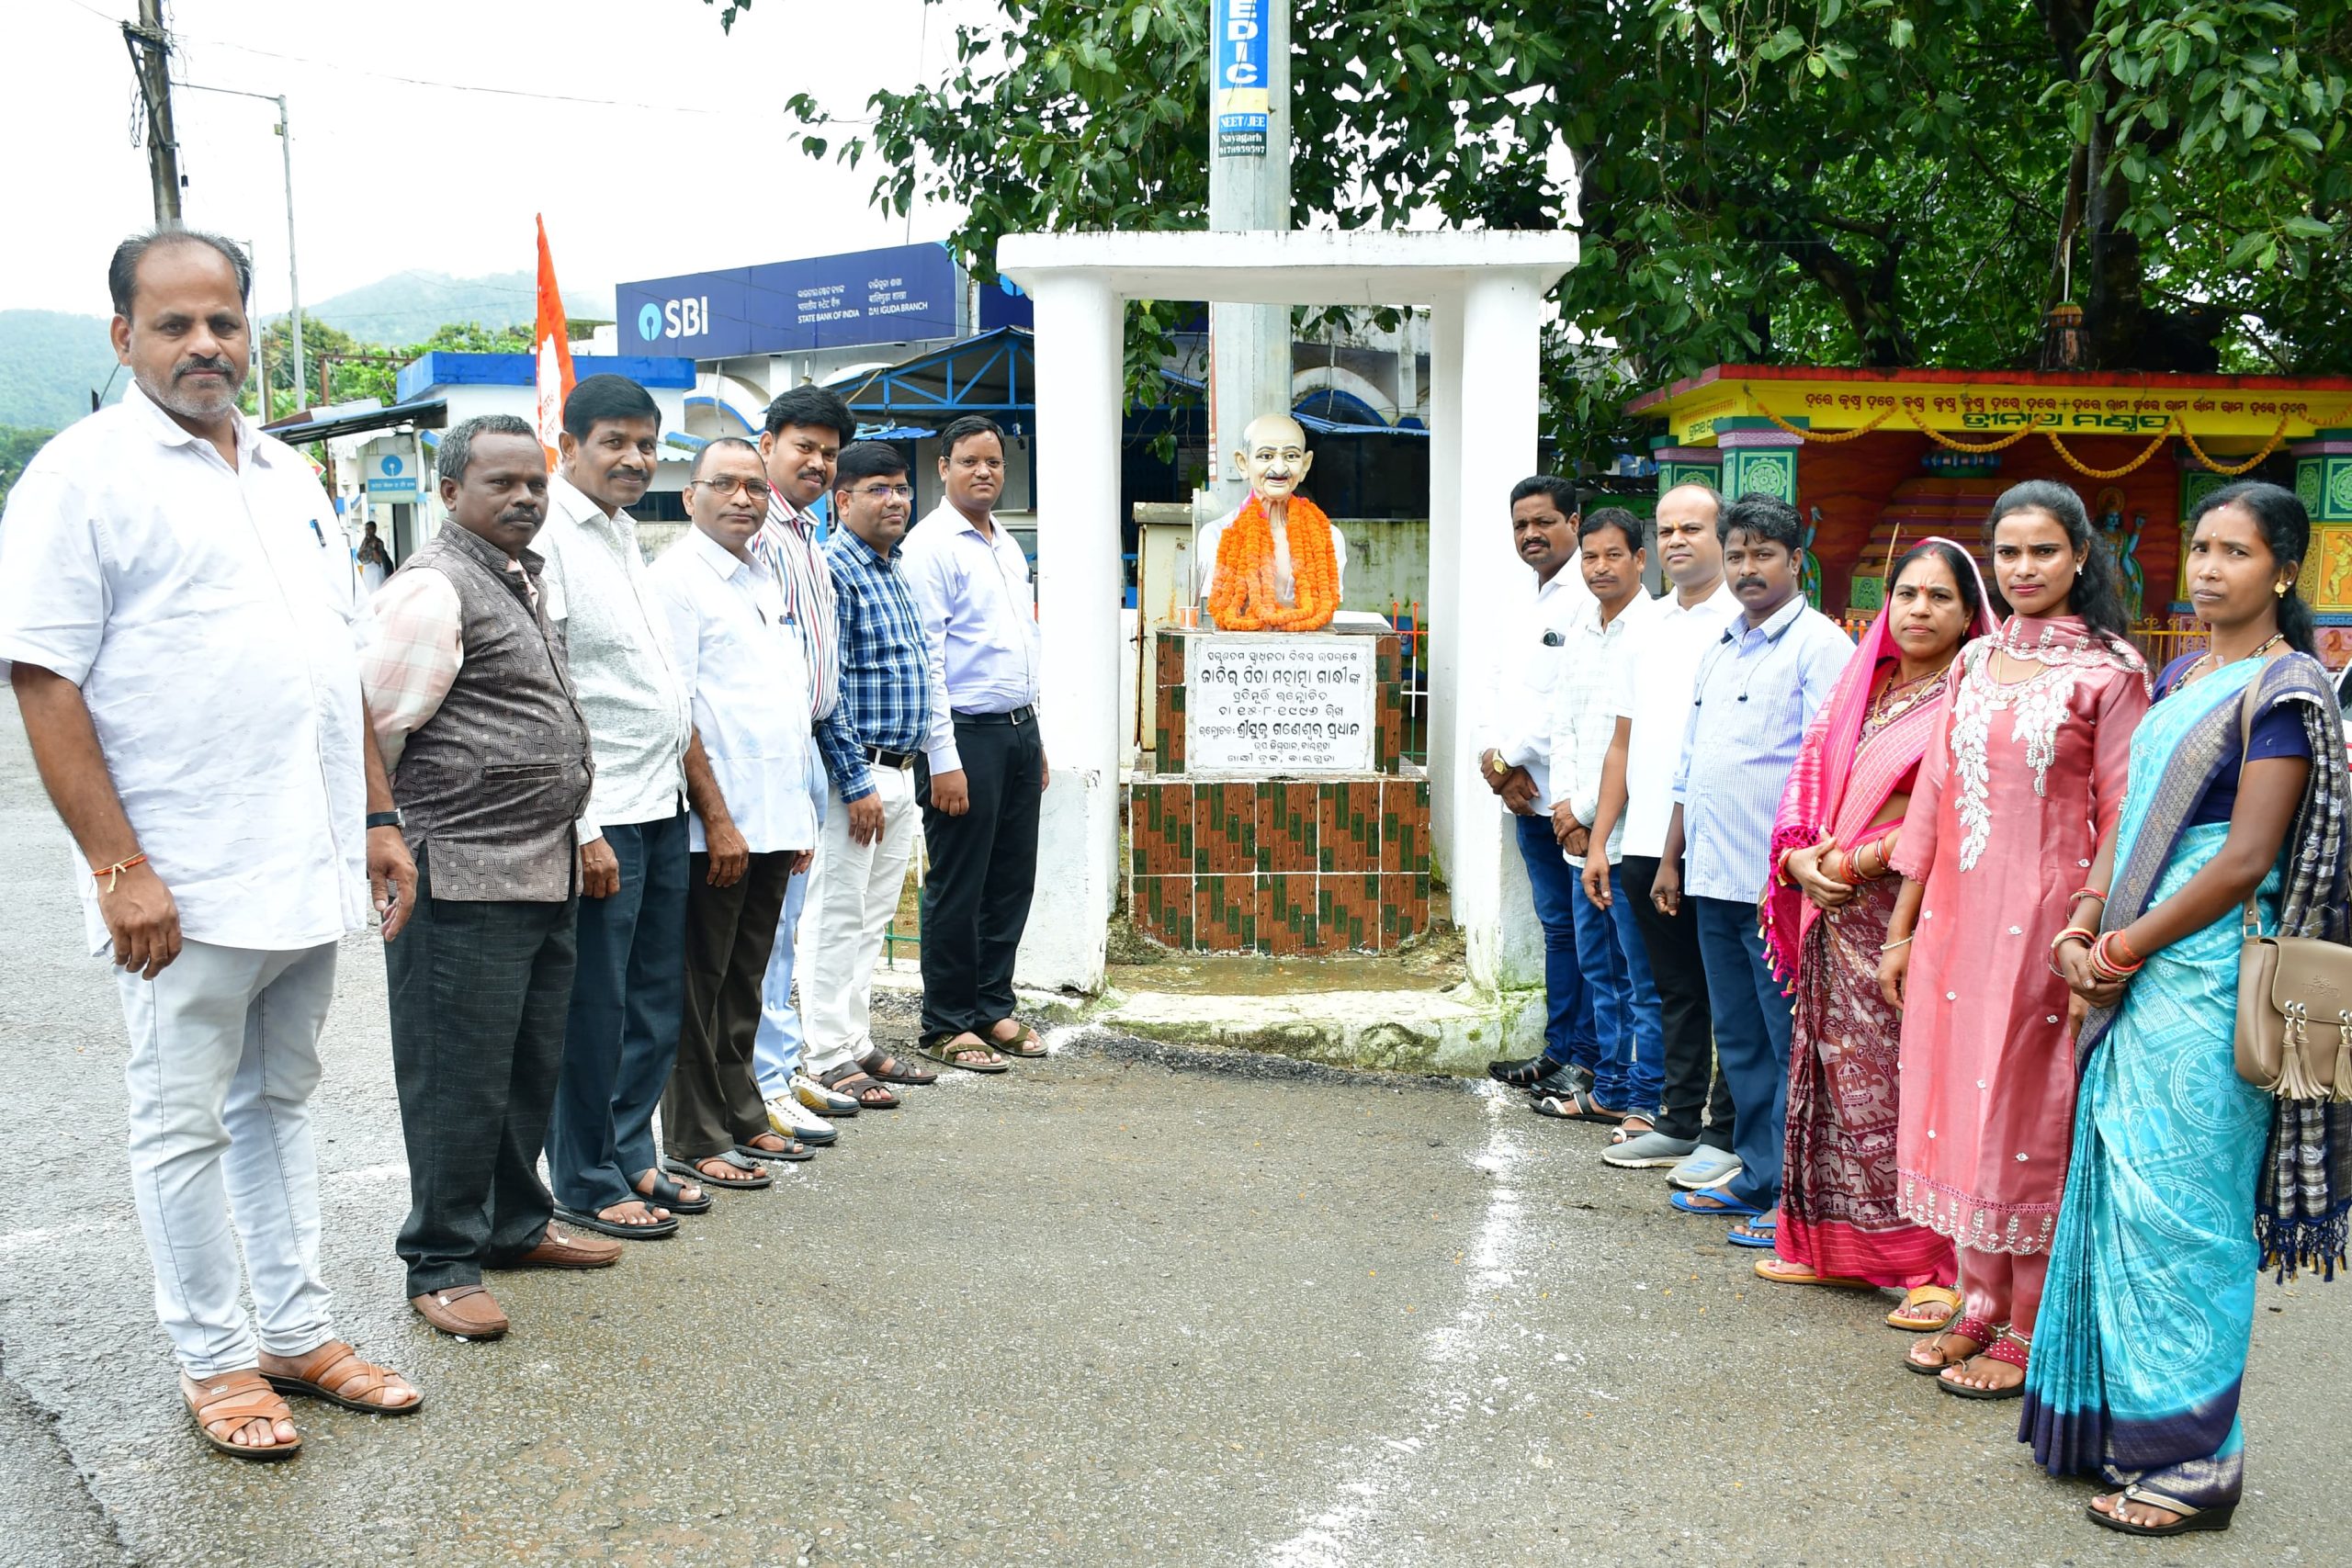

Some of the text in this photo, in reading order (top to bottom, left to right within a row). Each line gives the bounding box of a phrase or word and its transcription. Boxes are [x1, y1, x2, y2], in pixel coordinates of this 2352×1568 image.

[1221, 132, 1261, 143] Nayagarh
[900, 301, 928, 312] BRANCH
[665, 296, 708, 339] SBI
[797, 310, 860, 323] STATE BANK OF INDIA
[1202, 666, 1238, 685] ଜାତିର
[1244, 664, 1267, 682] ପିତା
[1328, 723, 1359, 739] ପ୍ରଧାନ
